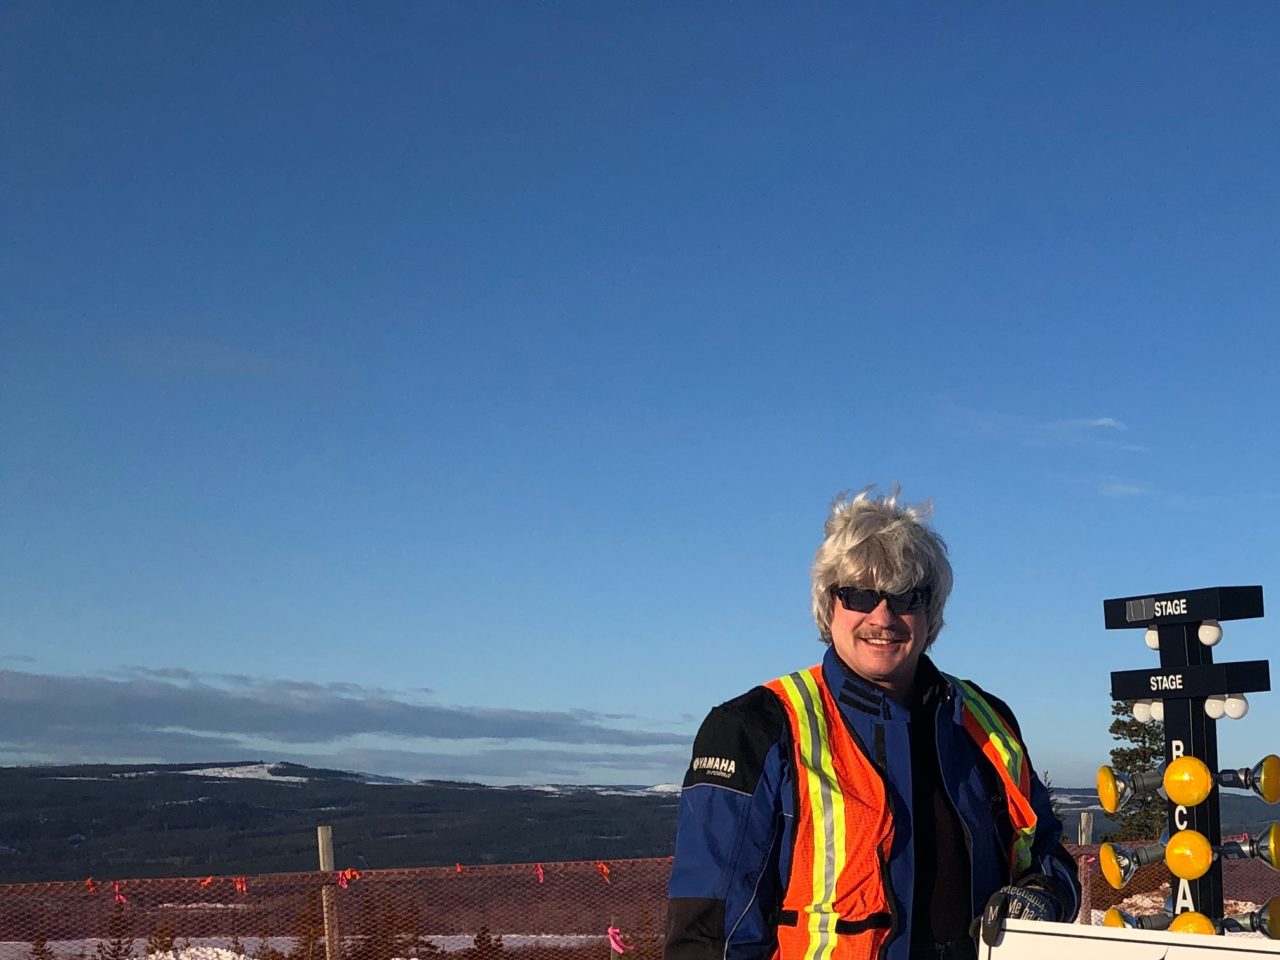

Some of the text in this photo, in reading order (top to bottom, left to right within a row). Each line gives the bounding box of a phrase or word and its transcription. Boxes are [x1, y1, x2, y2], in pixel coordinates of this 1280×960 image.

[1154, 599, 1187, 617] STAGE
[1150, 674, 1183, 691] STAGE
[698, 757, 736, 774] YAMAHA
[1175, 805, 1188, 831] C
[1175, 878, 1195, 915] A
